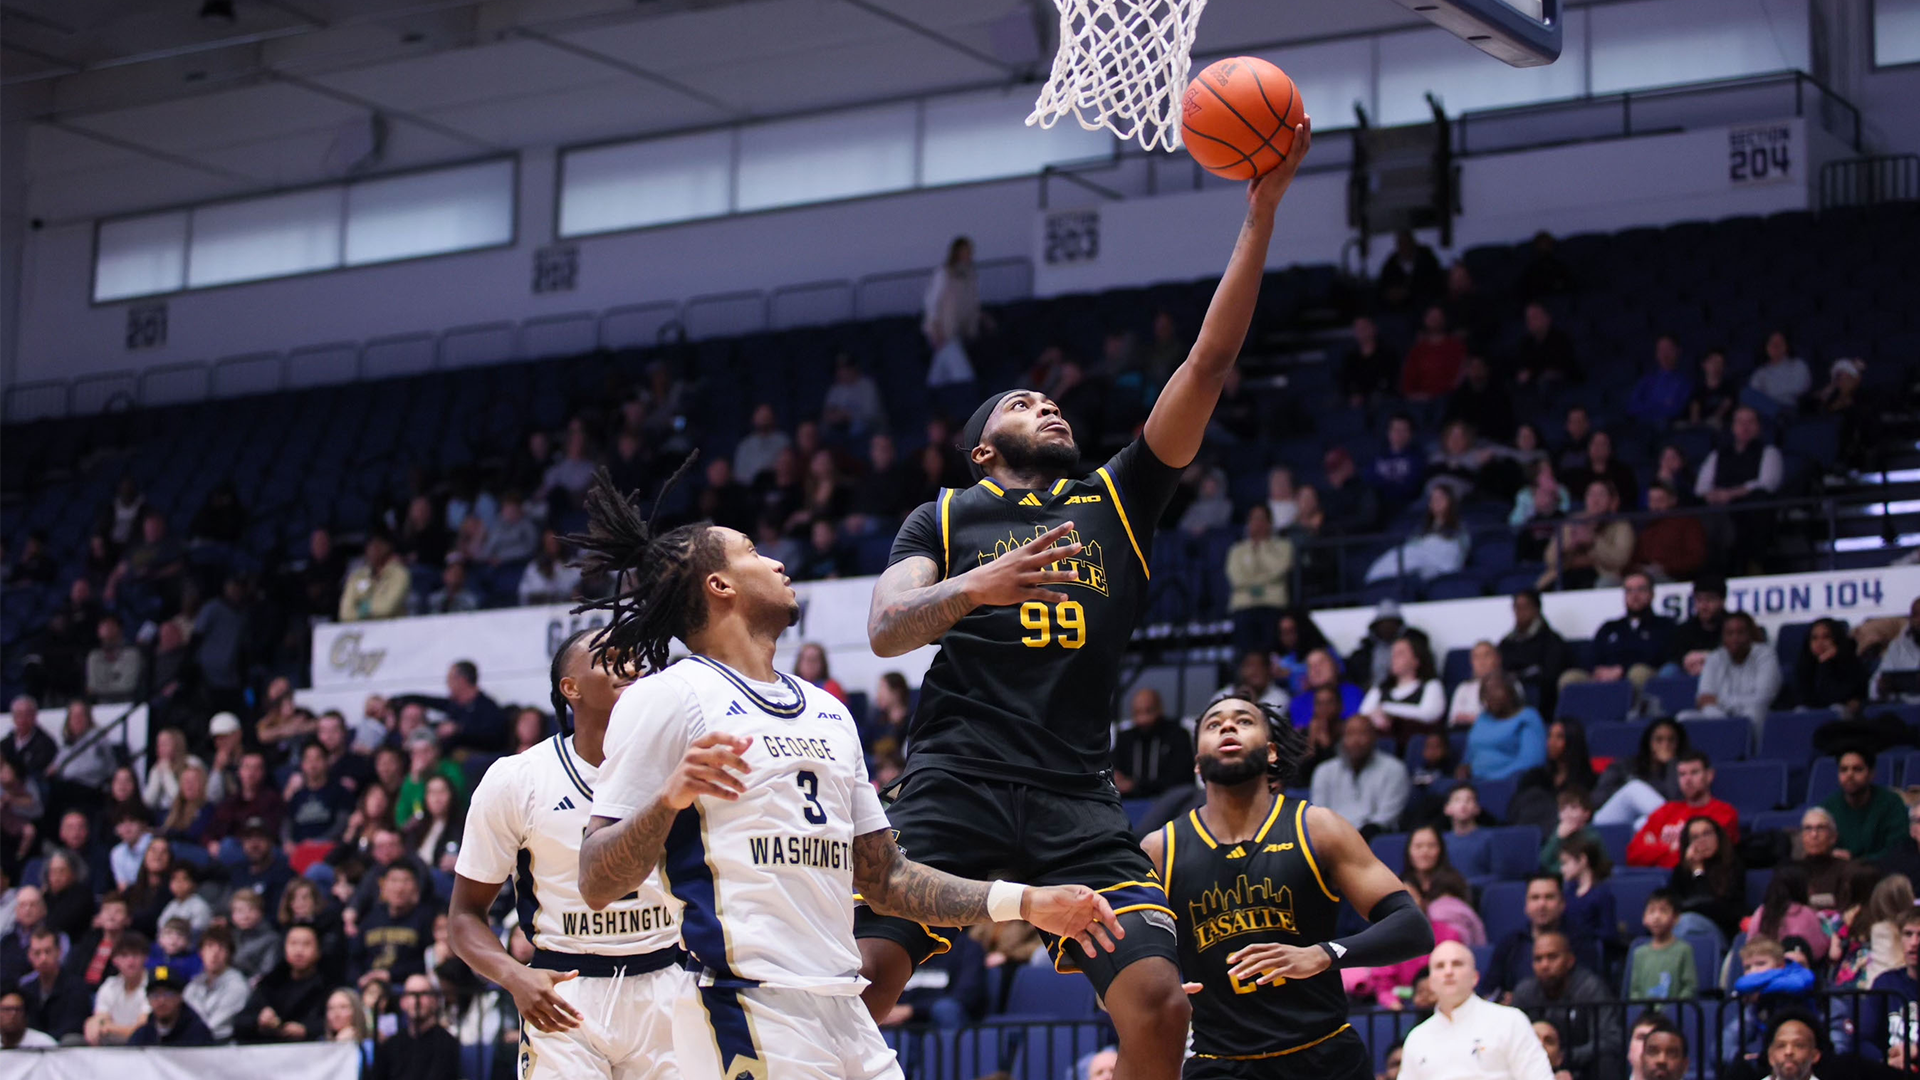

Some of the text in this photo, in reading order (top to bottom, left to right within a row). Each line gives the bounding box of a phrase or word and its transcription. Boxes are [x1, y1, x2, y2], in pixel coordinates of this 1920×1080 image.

[1730, 145, 1790, 181] 204
[1046, 228, 1099, 265] 203
[1064, 495, 1101, 505] A10
[1662, 578, 1883, 618] STION 104
[1019, 600, 1087, 649] 99
[763, 735, 836, 761] GEORGE
[796, 770, 827, 825] 3
[750, 836, 853, 872] WASHINGT
[562, 905, 675, 935] WASHINGTO
